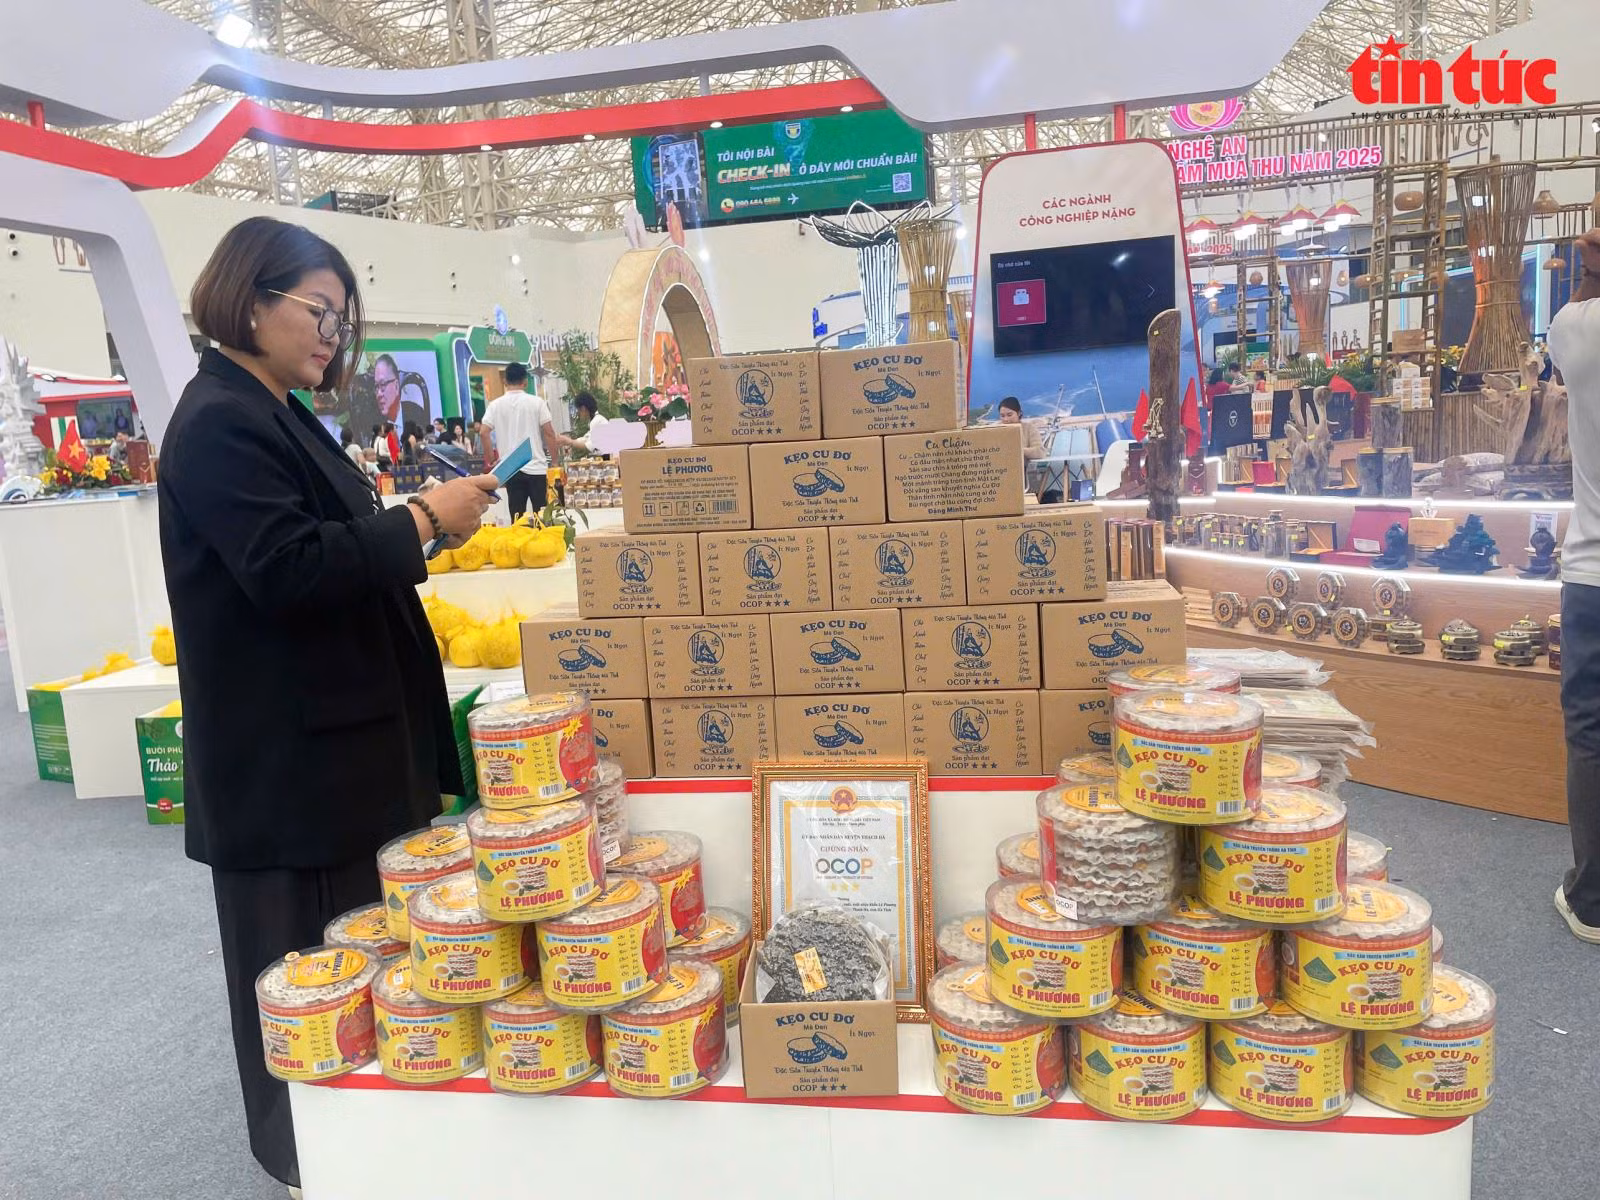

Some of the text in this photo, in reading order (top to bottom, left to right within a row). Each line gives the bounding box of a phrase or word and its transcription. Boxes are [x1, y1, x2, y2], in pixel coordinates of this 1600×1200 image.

[1166, 134, 1248, 164] NGHỆ AN
[1206, 159, 1248, 182] MÙA
[1251, 157, 1284, 177] THU
[1289, 149, 1332, 174] NĂM
[1335, 146, 1382, 169] 2025
[718, 163, 791, 183] CHECK-IN
[1042, 193, 1111, 209] CÁC NGÀNH
[1019, 207, 1136, 228] CÔNG NGHIỆP NẶNG
[852, 355, 924, 374] KẸO CU ĐƠ
[867, 422, 890, 431] OCOP
[783, 450, 853, 466] KẸO CU ĐƠ
[662, 465, 713, 477] LỆ PHƯƠNG
[797, 515, 819, 523] OCOP
[1010, 588, 1035, 596] OCOP
[740, 600, 764, 608] OCOP
[870, 596, 894, 604] OCOP
[1078, 611, 1152, 625] KẸO CU ĐƠ
[549, 628, 613, 641] KẸO CU ĐƠ
[800, 620, 868, 634] KẸO CU ĐƠ
[684, 684, 707, 692] OCOP
[814, 681, 836, 689] OCOP
[946, 678, 971, 686] OCOP
[804, 703, 870, 717] KẸO CU ĐƠ
[1078, 700, 1105, 711] KẸO
[597, 709, 614, 718] ĐƠ
[694, 763, 716, 771] OCOP
[1134, 751, 1209, 774] KẸO CU ĐƠ
[1135, 787, 1206, 809] LỆ PHƯƠNG
[494, 856, 561, 875] KẸO CU ĐƠ
[815, 858, 873, 875] OCOP
[1226, 854, 1305, 874] KẸO CU ĐƠ
[500, 890, 564, 908] LỆ PHƯƠNG
[1229, 891, 1304, 909] LỆ PHƯƠNG
[427, 944, 492, 958] KẸO CU ĐƠ
[549, 945, 611, 960] KẸO CU ĐƠ
[1010, 949, 1082, 970] KẸO CU ĐƠ
[1337, 961, 1415, 977] KẸO CU ĐƠ
[430, 978, 491, 991] LỆ PHƯƠNG
[553, 979, 611, 994] LỆ PHƯƠNG
[1012, 984, 1081, 1004] LỆ PHƯƠNG
[1340, 1001, 1415, 1016] LỆ PHƯƠNG
[775, 1012, 855, 1027] KẸO CU ĐƠ
[1404, 1050, 1480, 1065] KẸO CU ĐƠ
[1406, 1087, 1478, 1101] LỆ PHƯƠNG
